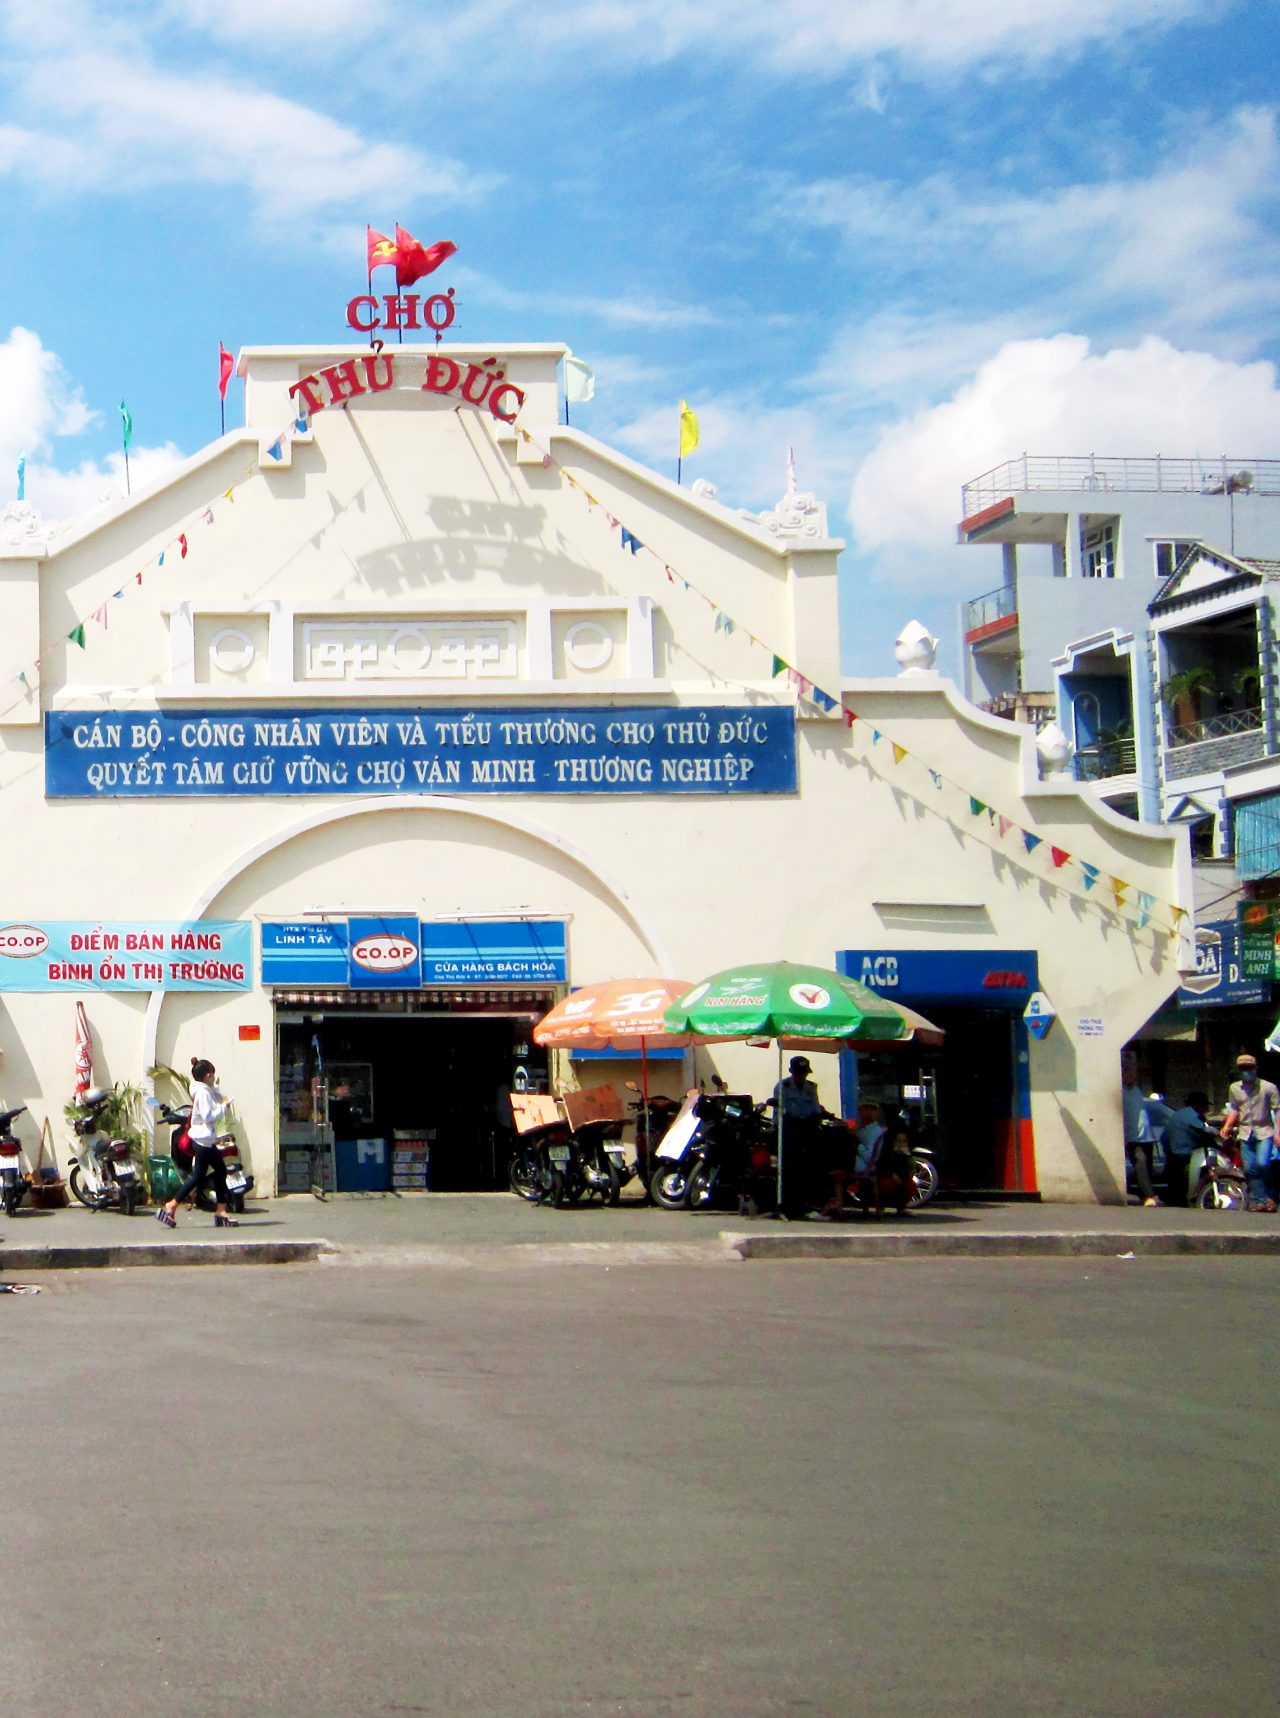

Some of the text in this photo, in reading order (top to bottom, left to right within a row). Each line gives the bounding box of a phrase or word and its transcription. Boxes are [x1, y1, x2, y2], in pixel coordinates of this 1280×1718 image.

[346, 287, 456, 342] CHỢ
[289, 339, 527, 425] THỦ ĐỨC
[72, 717, 122, 748] CÁN
[131, 718, 162, 751] BỘ
[180, 718, 245, 748] CÔNG
[254, 717, 321, 747] NHÂN
[330, 717, 388, 746] VIÊN
[396, 716, 427, 746] VÀ
[435, 712, 491, 746] TIỂU
[500, 718, 597, 746] THƯƠNG
[662, 713, 711, 745] THỦ
[718, 714, 769, 745] ĐỨC
[87, 752, 167, 790] QUYẾT
[173, 757, 225, 785] TÂM
[357, 757, 406, 790] CHỢ
[471, 760, 536, 784] MINH
[554, 755, 653, 783] THƯƠNG
[661, 753, 755, 787] NGHIỆP
[70, 924, 221, 951] ĐIỂM BÁN HÀNG
[275, 933, 333, 944] LINH TÂY
[356, 947, 414, 959] CO.OP
[434, 961, 557, 972] CỬA HÀNG BÁCH HÓA
[1243, 949, 1273, 961] MINH
[48, 955, 244, 983] BÌNH ỔN THỊ TRƯỜNG
[860, 956, 899, 987] ACB
[1246, 963, 1270, 975] ANH
[605, 989, 667, 1017] 3G
